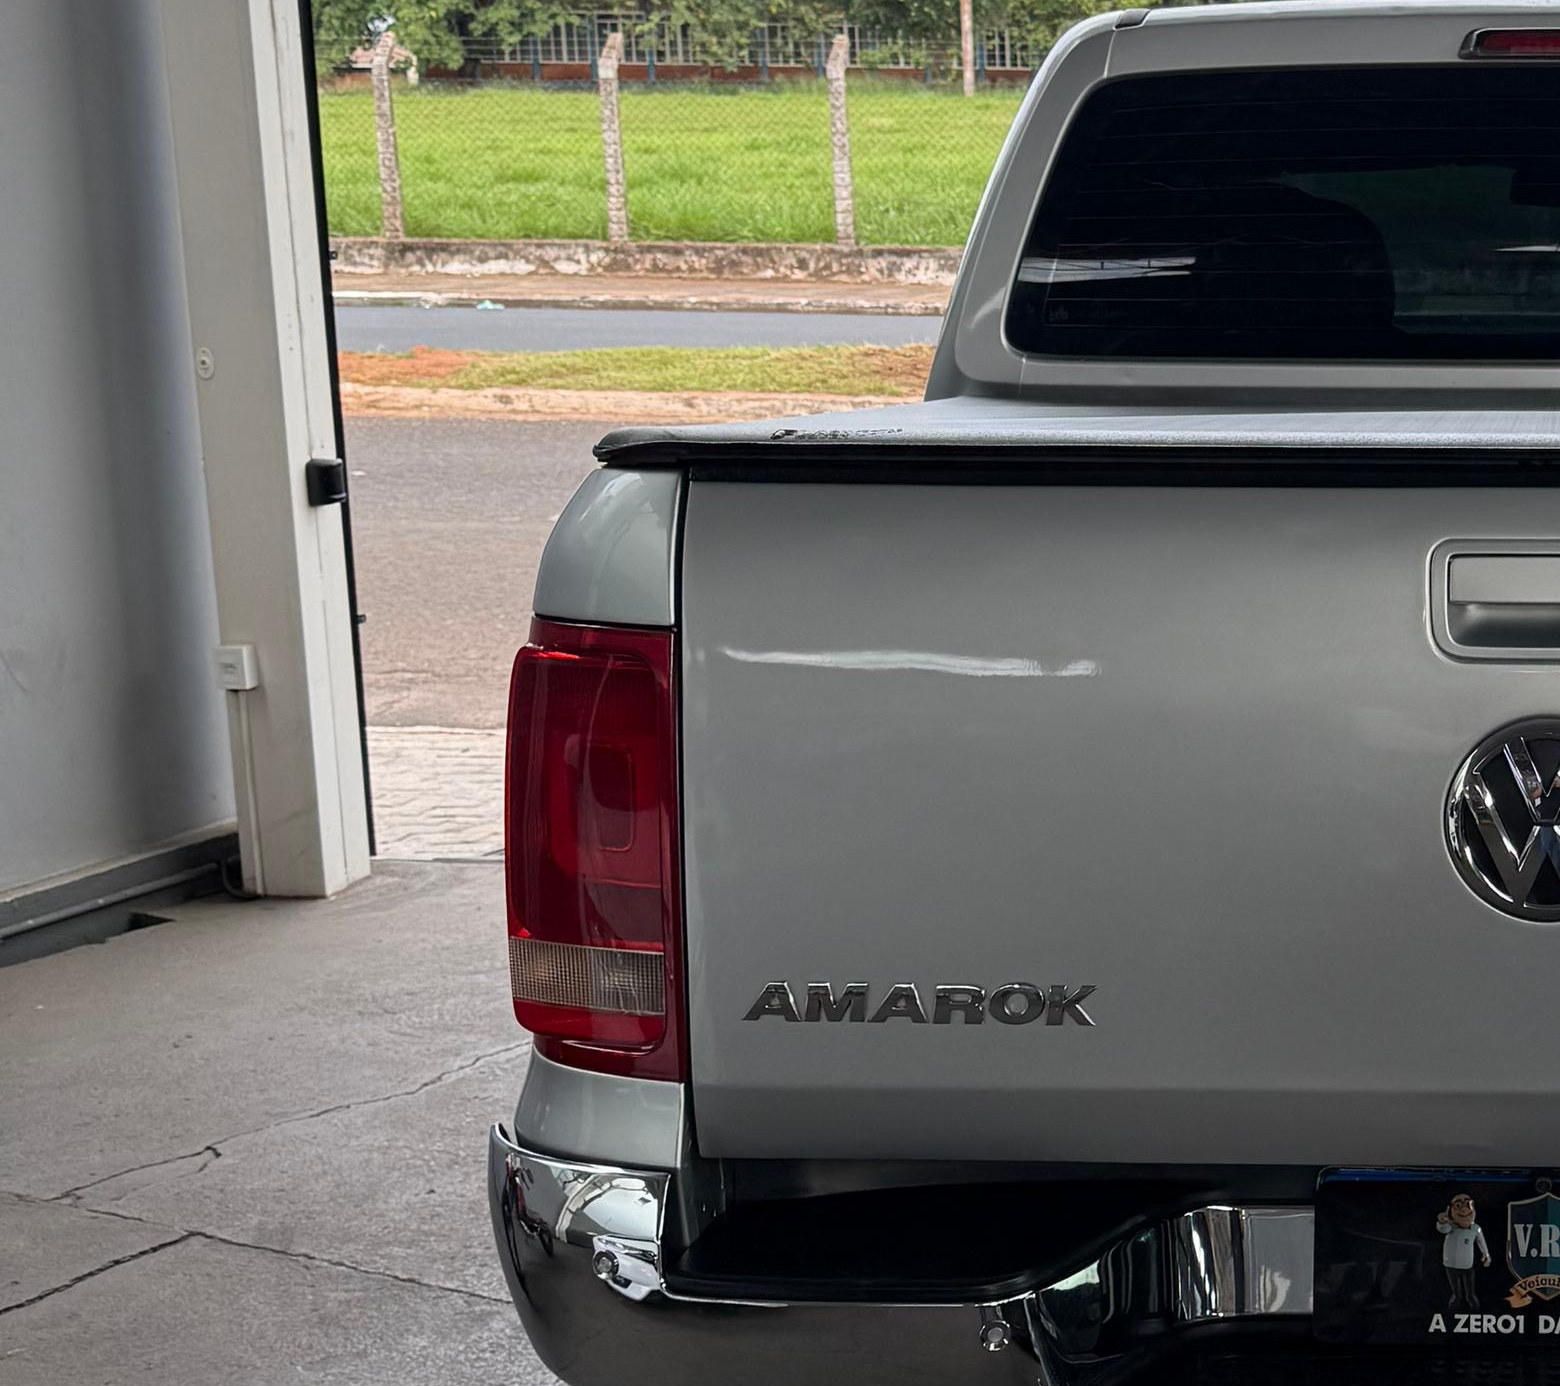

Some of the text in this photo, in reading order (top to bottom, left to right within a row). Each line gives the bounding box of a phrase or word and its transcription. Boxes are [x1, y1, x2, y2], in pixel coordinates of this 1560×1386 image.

[742, 979, 1099, 1027] AMAROK
[1428, 1313, 1447, 1333] A
[1453, 1314, 1525, 1334] ZERO1
